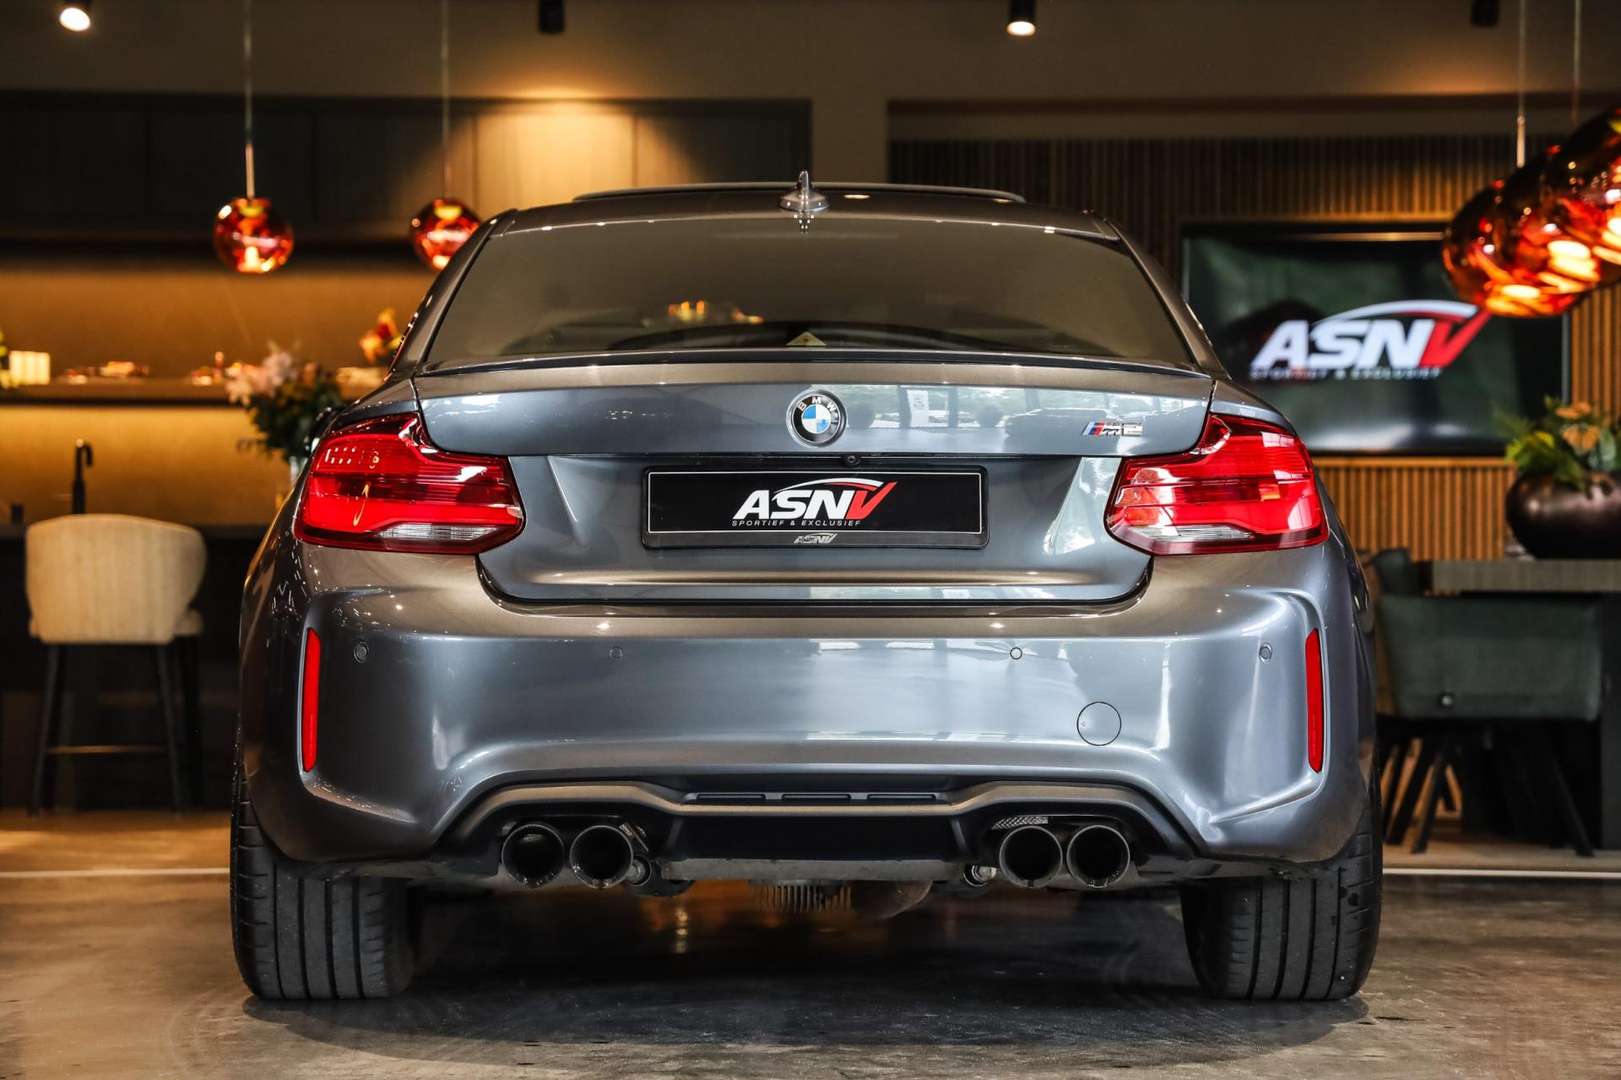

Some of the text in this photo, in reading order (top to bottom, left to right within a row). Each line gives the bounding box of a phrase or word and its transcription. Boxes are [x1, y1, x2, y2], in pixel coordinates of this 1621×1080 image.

[1250, 302, 1492, 369] ASNV
[796, 396, 836, 411] BMW
[732, 480, 898, 520] ASNV
